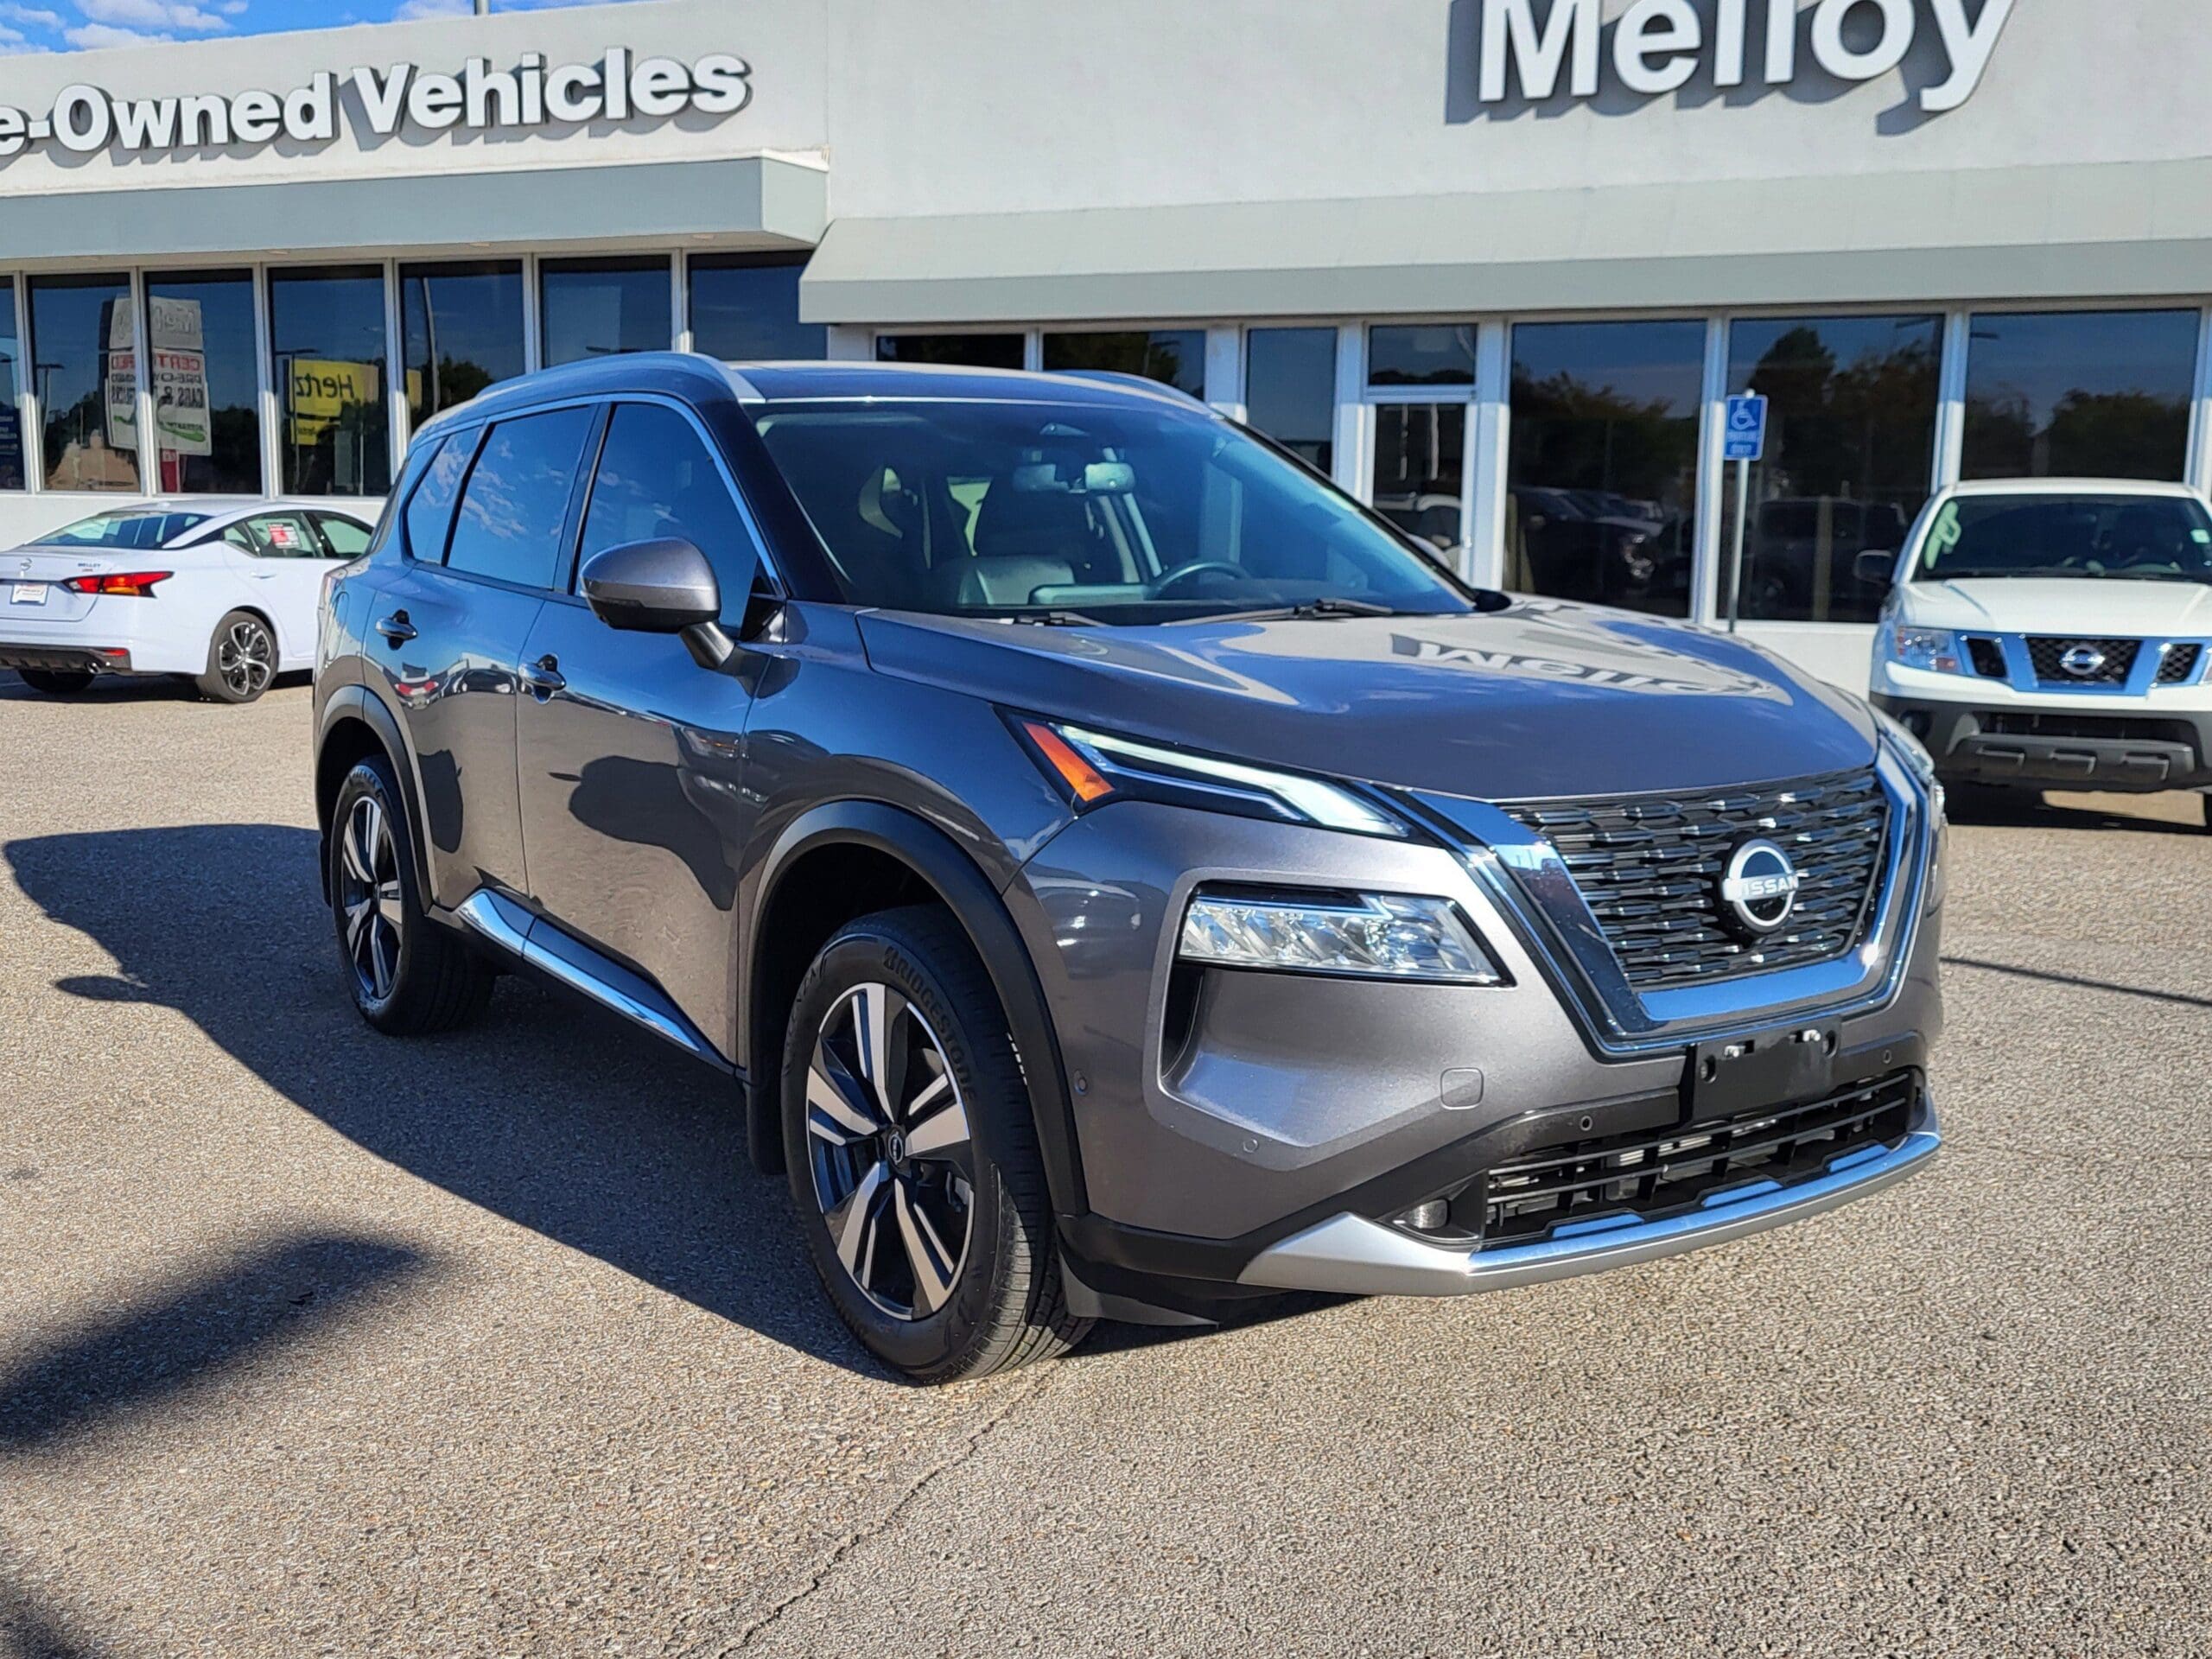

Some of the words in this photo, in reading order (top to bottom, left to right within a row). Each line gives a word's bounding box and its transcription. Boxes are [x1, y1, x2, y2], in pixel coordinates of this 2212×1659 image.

[352, 47, 751, 135] Vehicles
[1478, 0, 2012, 112] Melloy
[1729, 874, 1799, 897] ISSAN
[883, 945, 976, 1100] BRIDGESTONE
